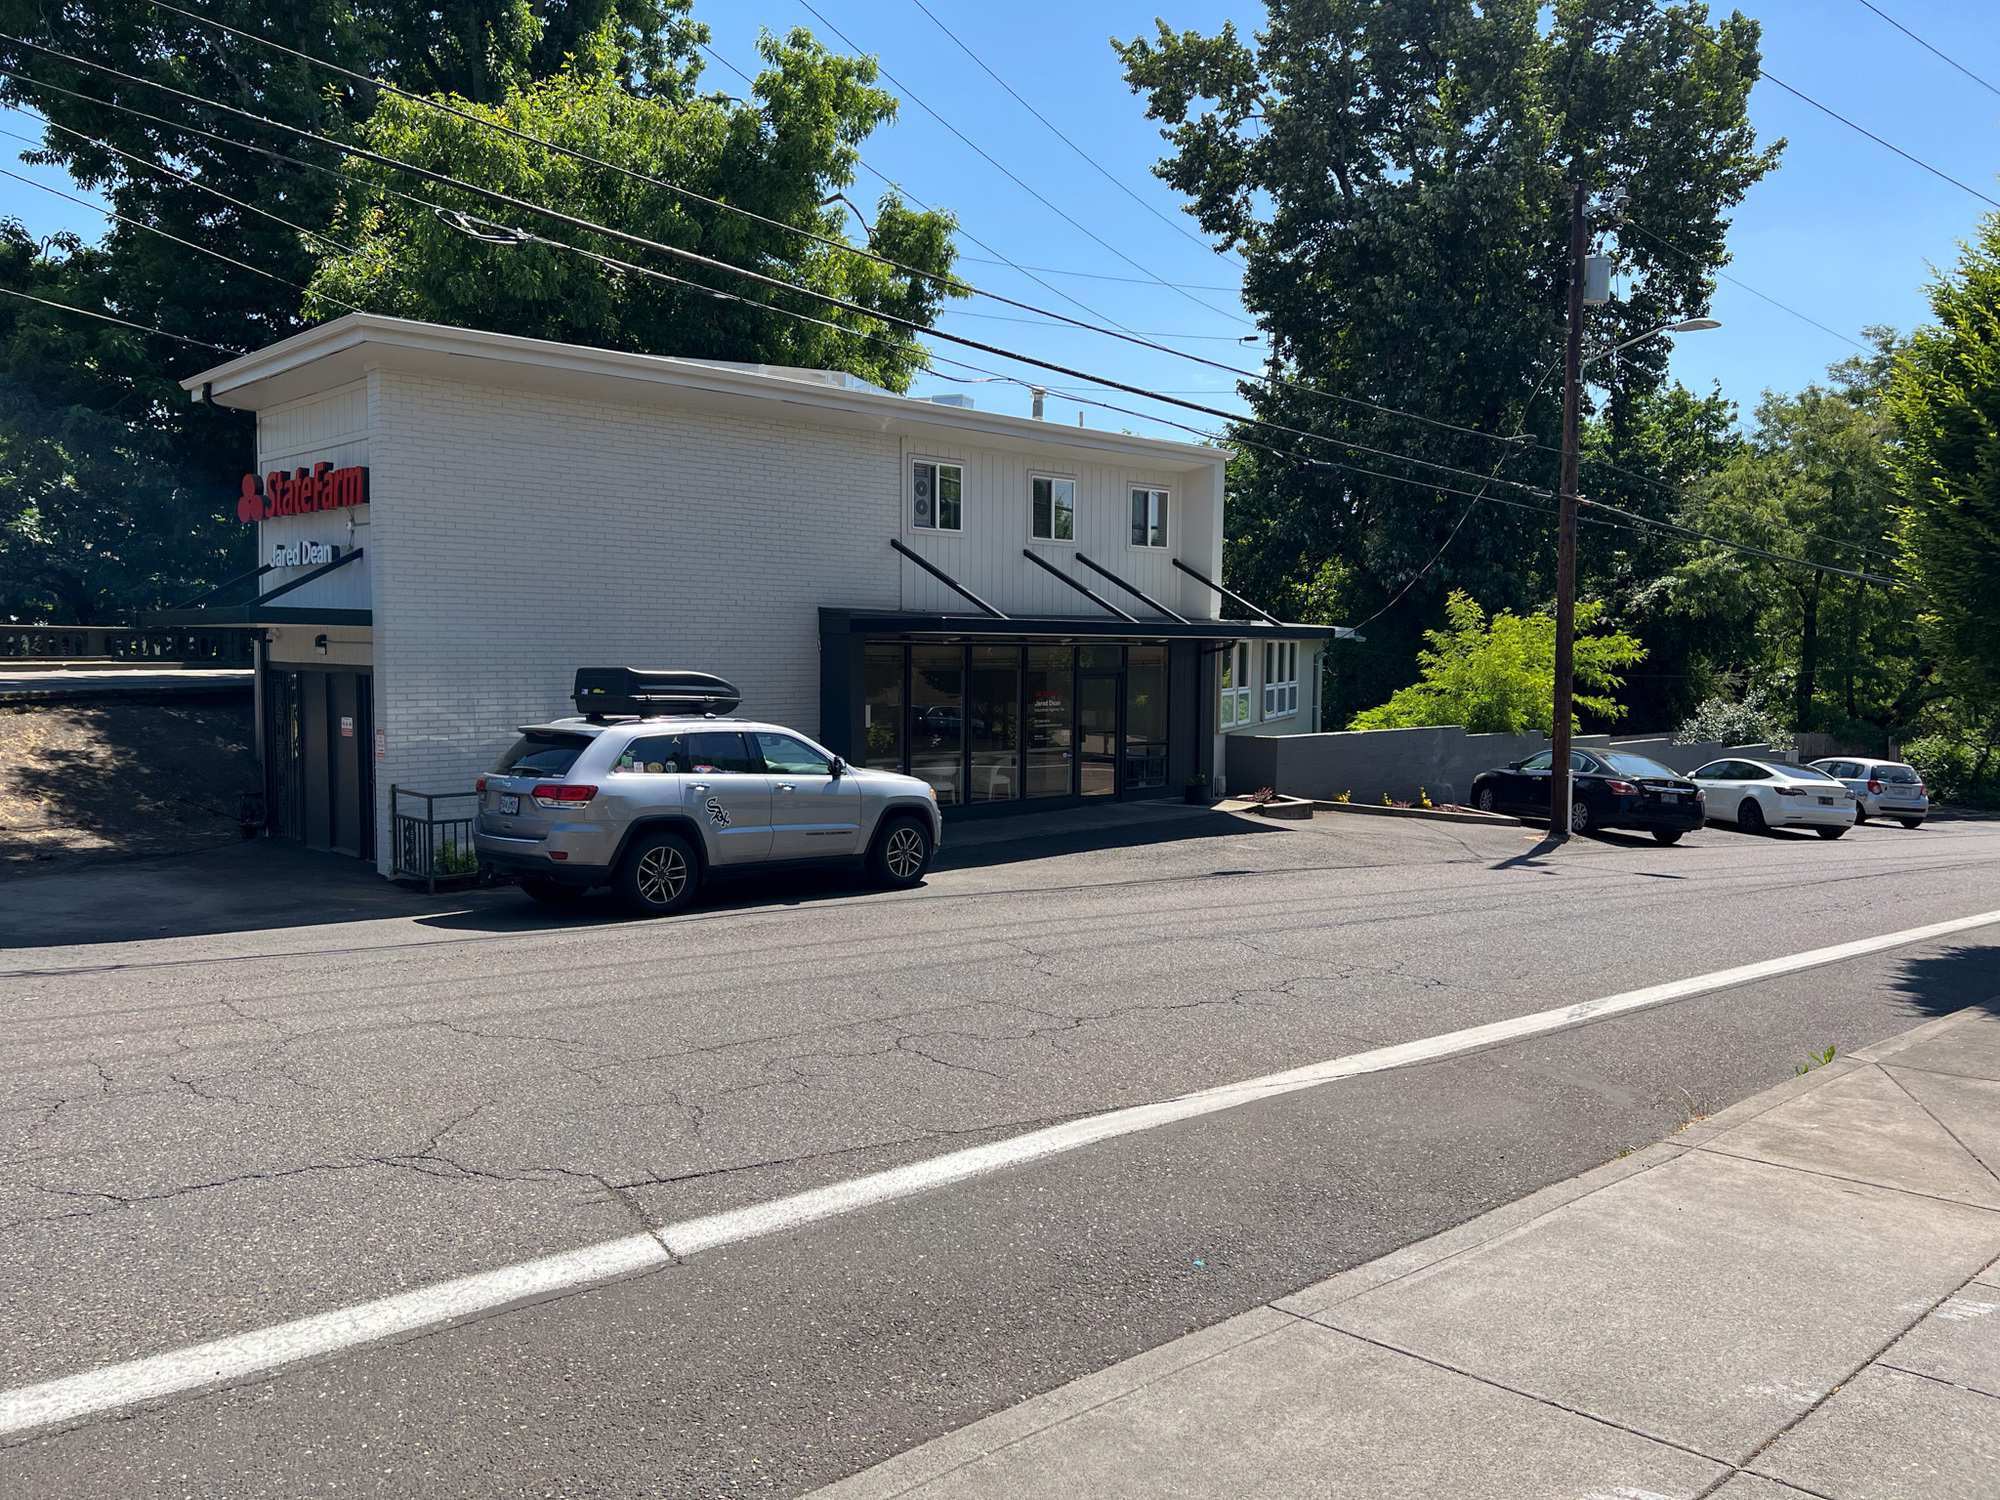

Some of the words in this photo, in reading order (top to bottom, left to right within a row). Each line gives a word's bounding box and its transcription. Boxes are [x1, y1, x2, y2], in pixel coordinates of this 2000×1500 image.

[270, 541, 300, 567] Jared
[302, 541, 333, 564] Dean
[705, 796, 731, 829] Sox
